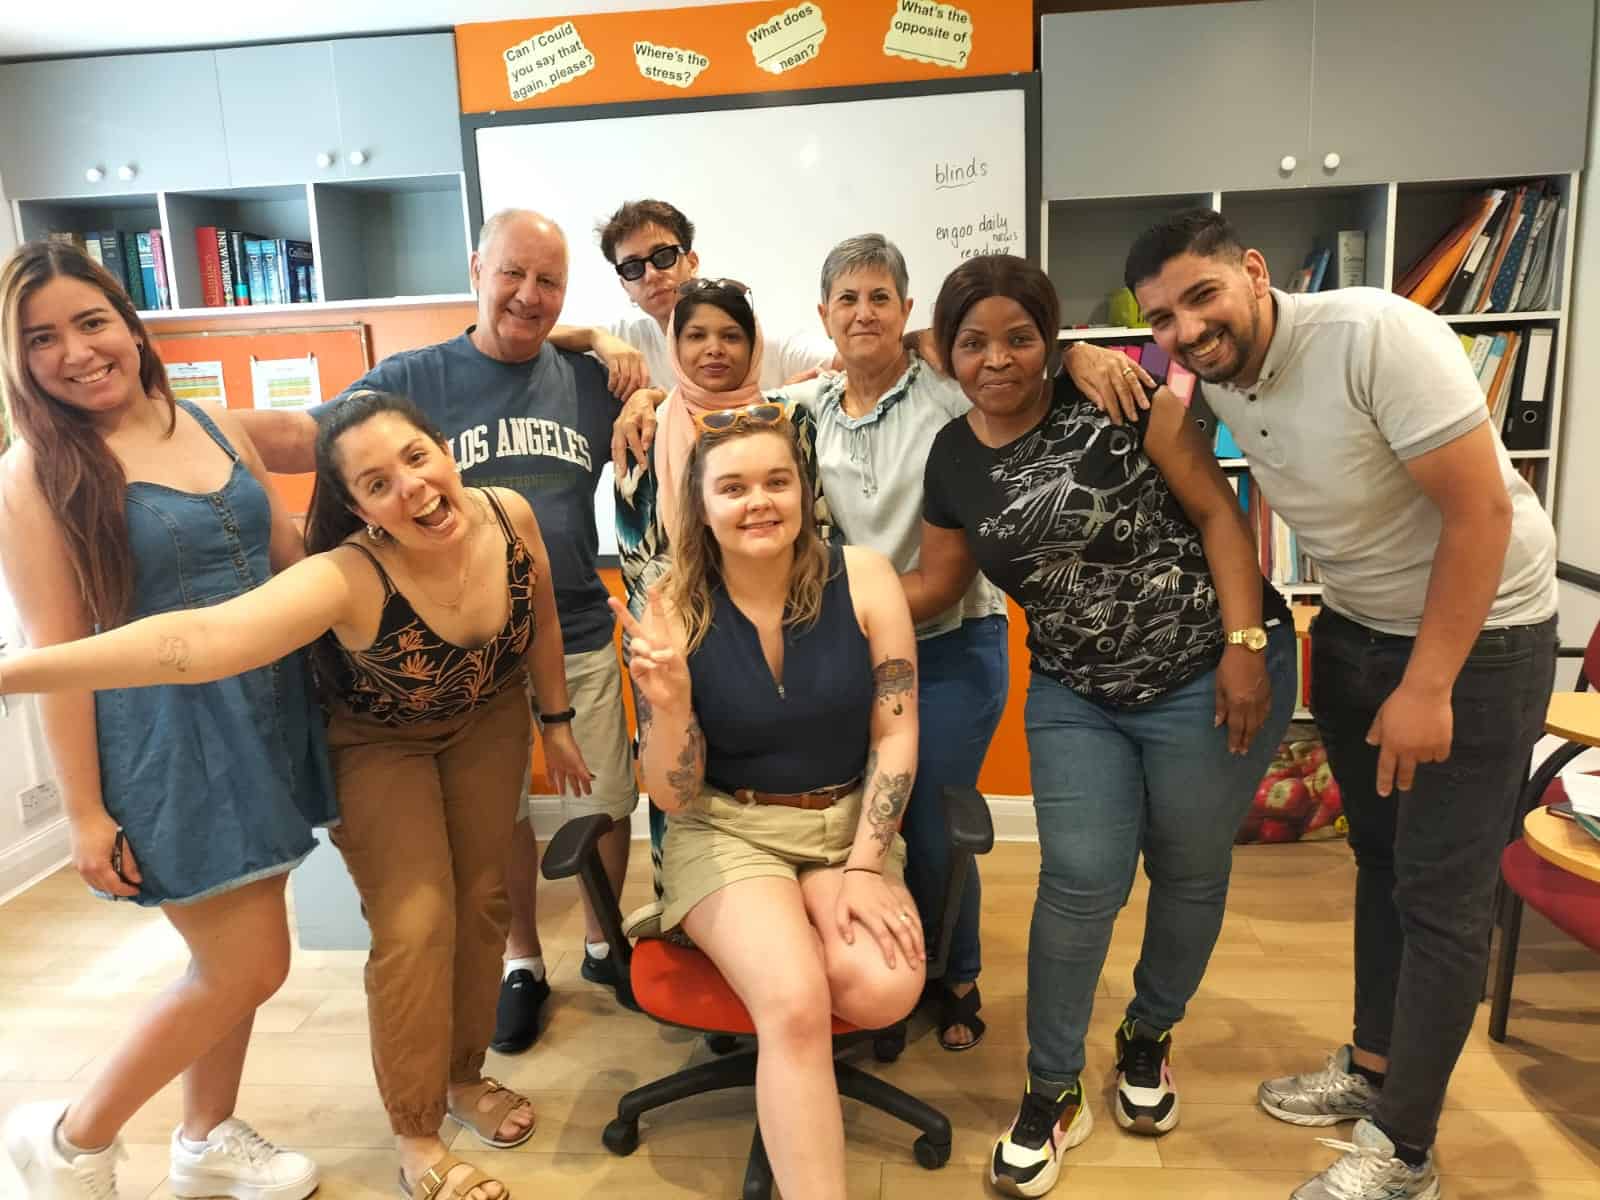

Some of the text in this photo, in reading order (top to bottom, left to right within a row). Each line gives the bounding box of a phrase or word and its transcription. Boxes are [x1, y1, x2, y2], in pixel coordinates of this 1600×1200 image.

[749, 5, 814, 44] What does
[902, 1, 968, 25] What's the
[505, 44, 531, 63] Can
[537, 23, 574, 48] Could
[895, 19, 968, 44] opposite of
[511, 40, 583, 83] you say that
[635, 44, 708, 68] Where's the
[512, 55, 593, 100] again, please?
[645, 65, 692, 83] stress?
[935, 156, 988, 184] blinds
[979, 212, 1008, 235] daily
[448, 417, 593, 473] LOS ANGELES
